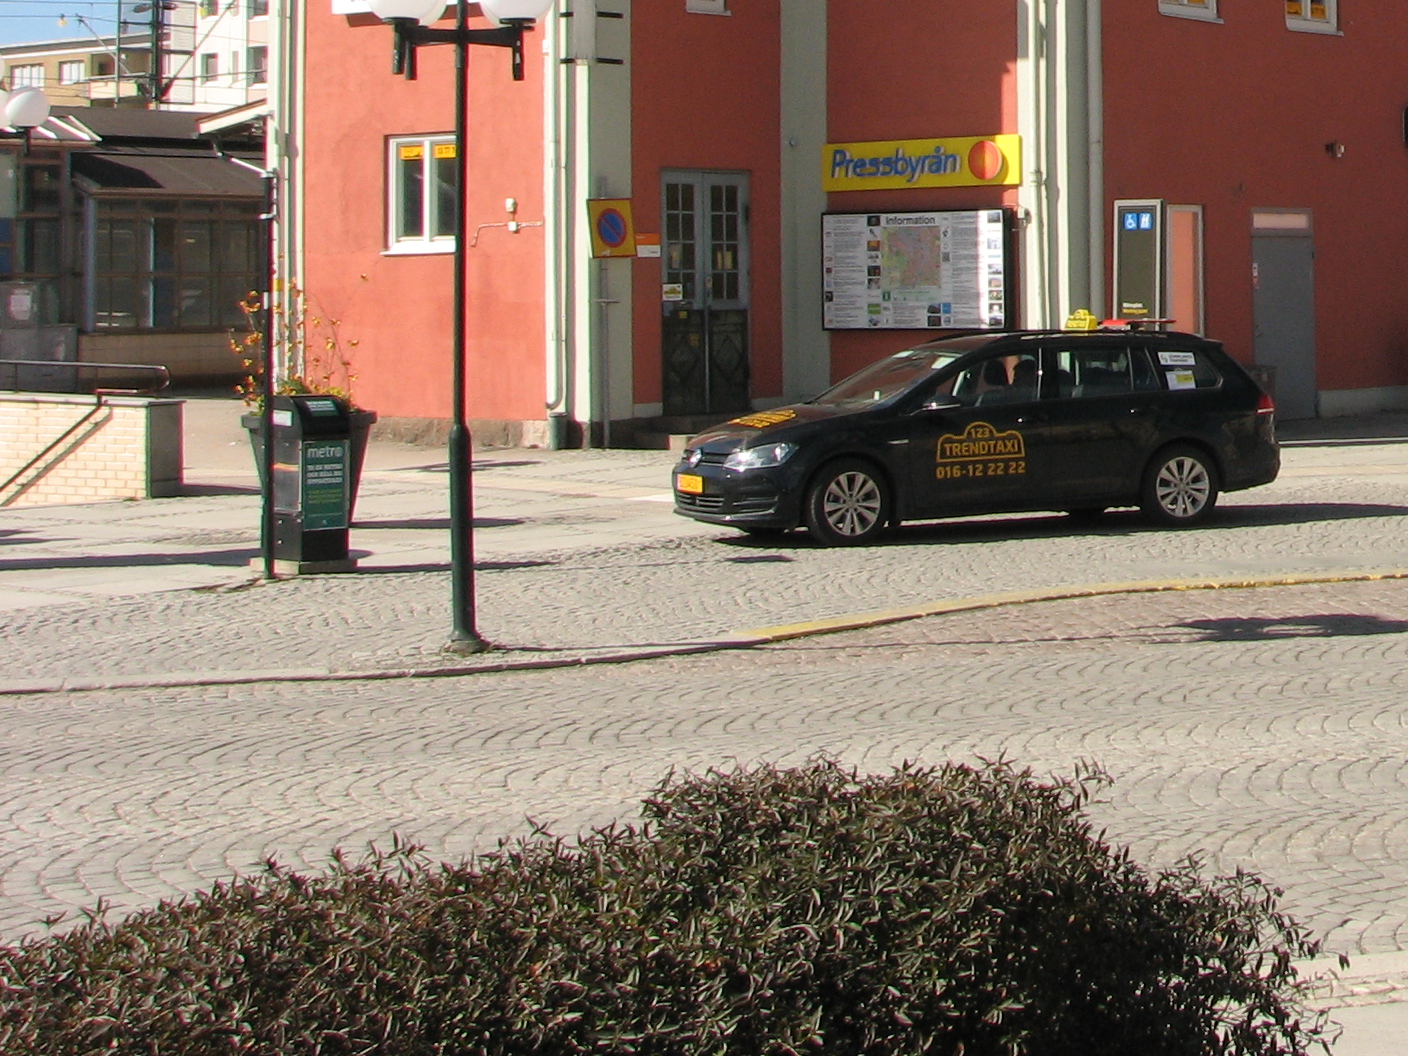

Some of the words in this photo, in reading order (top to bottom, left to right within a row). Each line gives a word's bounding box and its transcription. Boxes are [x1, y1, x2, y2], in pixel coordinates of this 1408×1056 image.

[831, 146, 962, 183] Pressbyrån
[886, 216, 936, 225] Information
[970, 428, 990, 439] 123
[306, 445, 344, 458] metro
[943, 439, 1019, 456] TRENDTAXI
[936, 464, 984, 479] 016-12
[987, 463, 1005, 475] 22
[1008, 461, 1026, 474] 22
